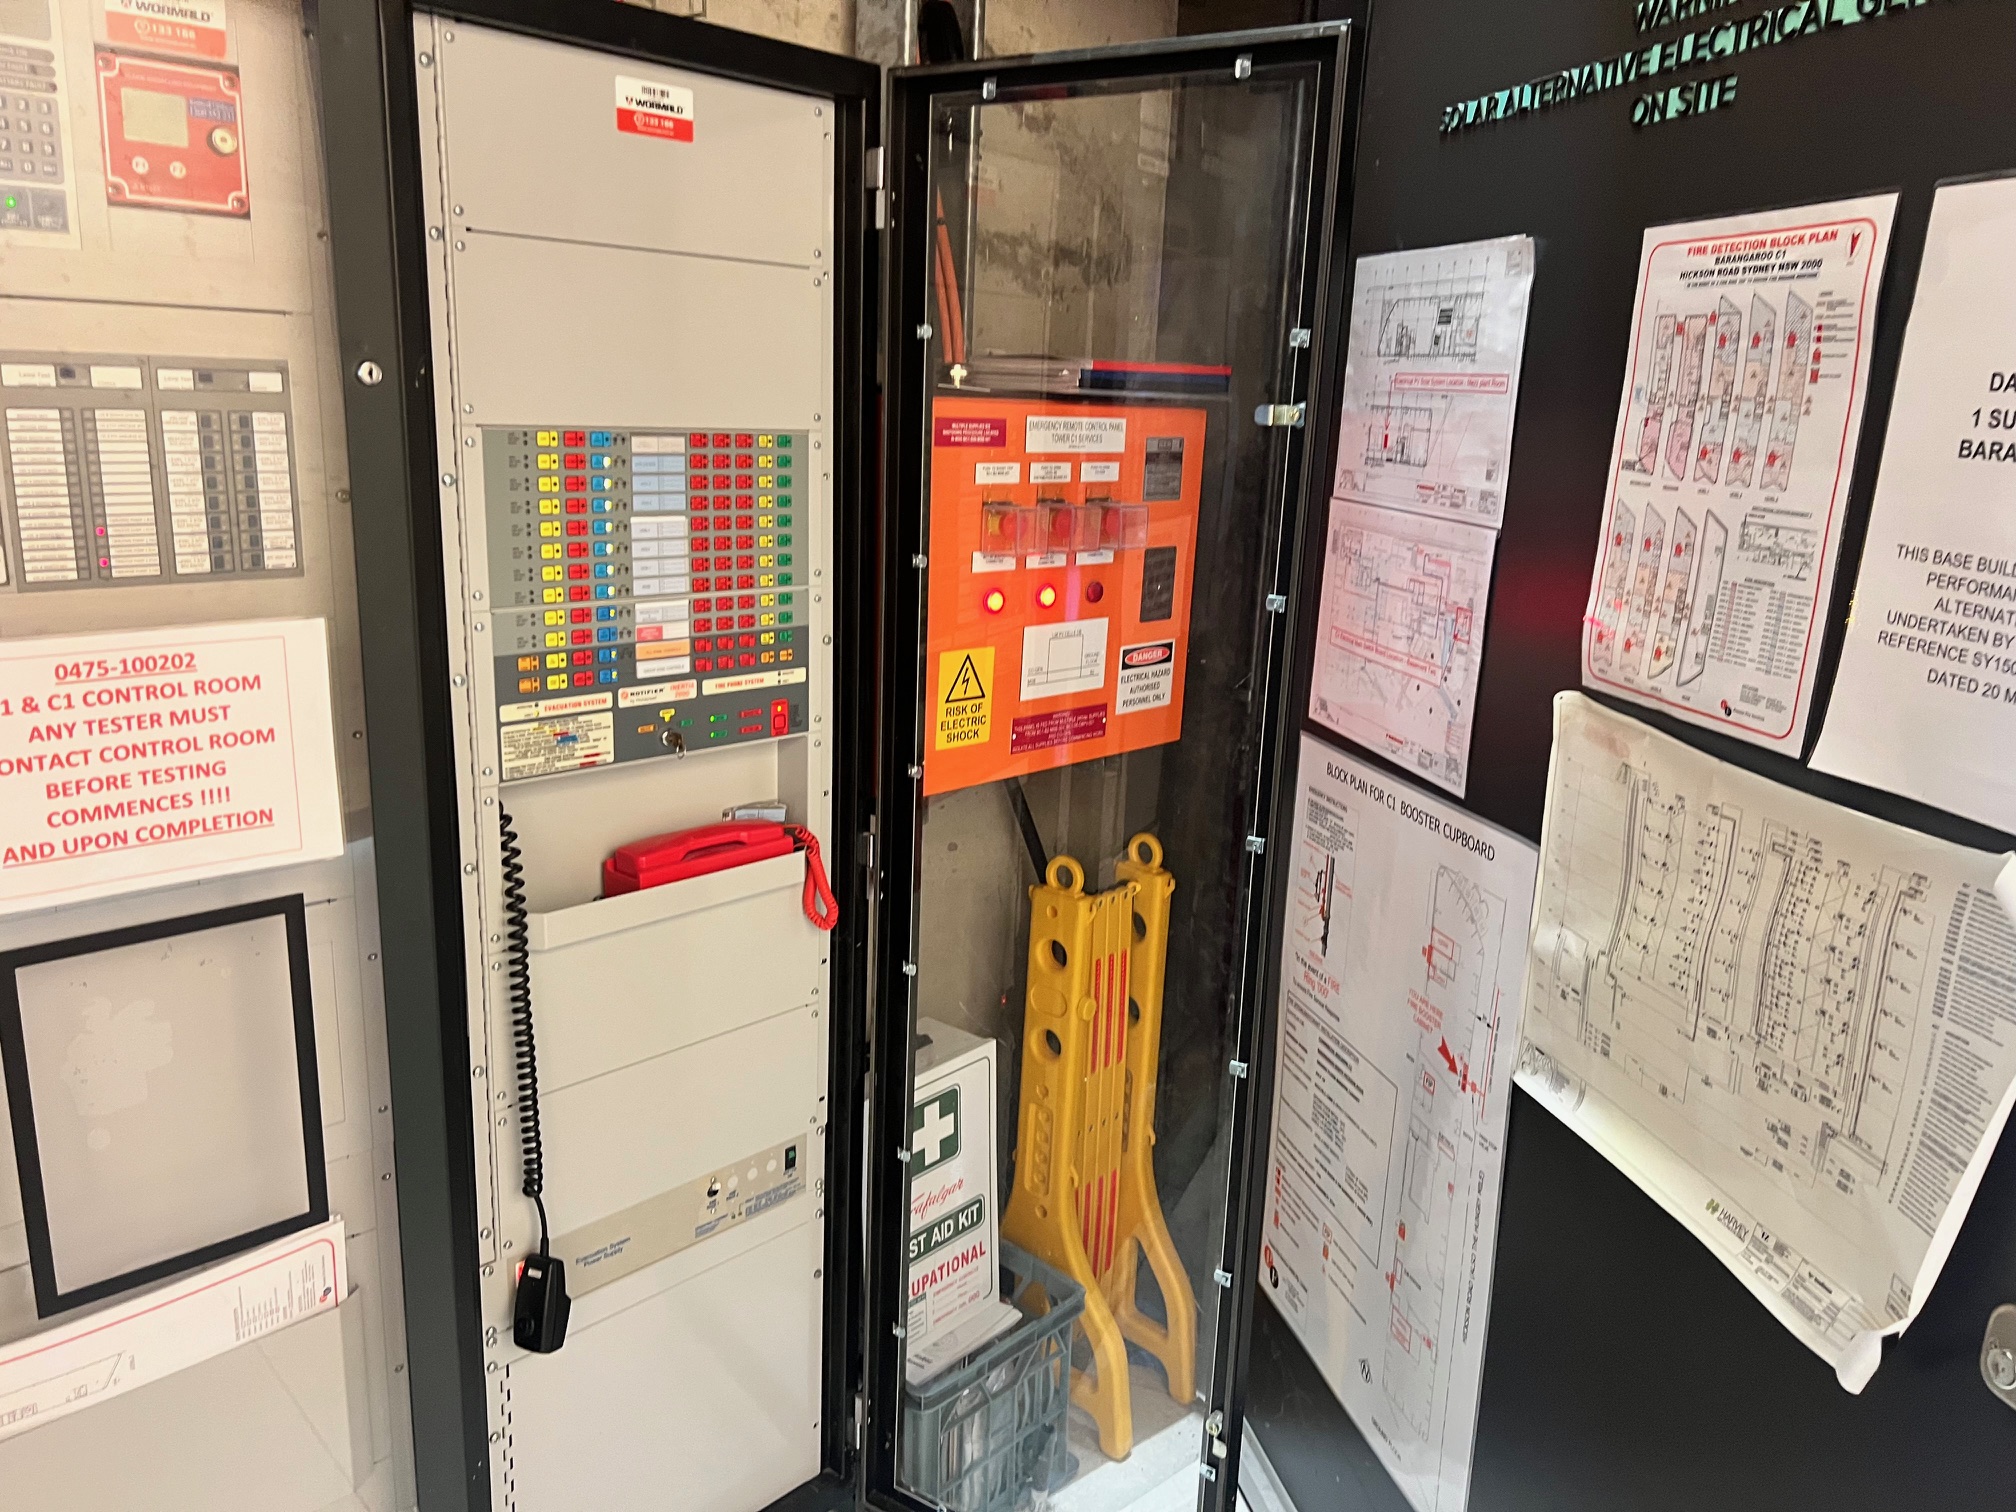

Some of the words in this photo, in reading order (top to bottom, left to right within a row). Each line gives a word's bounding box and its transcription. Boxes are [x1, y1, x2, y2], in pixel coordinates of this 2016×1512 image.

[1499, 50, 1654, 120] ALTERNATIVE
[1657, 0, 1846, 74] ELECTRICAL
[635, 98, 684, 115] WORMALD
[1629, 90, 1671, 127] ON
[1675, 73, 1740, 120] SITE
[1687, 244, 1708, 257] FIRE
[1710, 238, 1768, 255] DETECTION
[1770, 234, 1807, 249] BLOCK
[1808, 229, 1839, 244] PLAN
[1679, 268, 1715, 281] HICKSON
[1716, 265, 1740, 278] ROAD
[1741, 261, 1777, 275] SYDNEY
[1778, 260, 1800, 272] NSW
[1801, 258, 1824, 270] 2000
[1714, 251, 1774, 265] BARANGAROO
[1028, 420, 1062, 432] EMERGENCY
[1062, 421, 1084, 432] REMOTE
[1084, 421, 1108, 432] CONTROL
[1108, 422, 1124, 432] PANEL
[1972, 407, 1982, 428] 1
[1988, 408, 2016, 430] SU
[1051, 433, 1071, 443] TOWER
[1078, 433, 1103, 444] SERVICES
[1958, 438, 2016, 463] BARA
[1897, 543, 1929, 563] THIS
[1932, 549, 1974, 571] BASE
[1926, 571, 2016, 602] PERFORMA
[1933, 596, 2016, 628] ALTERNAT
[1887, 608, 1990, 645] UNDERTAKEN
[1992, 631, 2015, 650] BY
[1132, 649, 1163, 664] DANGER
[1877, 630, 1970, 664] REFERENCE
[54, 652, 197, 682] 0475-100202
[1120, 671, 1150, 684] ELECTRICAL
[1150, 668, 1171, 679] HAZARD
[21, 696, 41, 714] &
[47, 693, 75, 712] C1
[82, 682, 188, 708] CONTROL
[194, 675, 262, 697] ROOM
[744, 678, 765, 686] SYSTEM
[1130, 681, 1161, 694] AUTHORISED
[1926, 667, 1979, 694] DATED
[1981, 682, 2001, 700] 20
[544, 701, 582, 713] EVACUATION
[583, 698, 607, 706] SYSTEM
[945, 704, 968, 718] RISK
[970, 702, 983, 714] OF
[1122, 695, 1151, 708] PERSONNEL
[1152, 692, 1166, 703] ONLY
[28, 721, 77, 743] ANY
[83, 713, 164, 737] TESTER
[169, 704, 231, 727] MUST
[940, 714, 987, 731] ELECTRIC
[946, 728, 979, 743] SHOCK
[99, 737, 204, 764] CONTROL
[209, 727, 276, 750] ROOM
[46, 773, 132, 800] BEFORE
[138, 760, 227, 787] TESTING
[46, 791, 194, 829] COMMENCES
[201, 786, 231, 806] !!!!
[1326, 761, 1348, 784] BLOCK
[1349, 773, 1368, 796] PLAN
[1369, 785, 1385, 806] FOR
[1386, 794, 1396, 811] C1
[1400, 800, 1440, 834] BOOSTER
[1443, 822, 1495, 861] CUPBOARD
[3, 842, 55, 865] AND
[62, 829, 128, 856] UPON
[135, 808, 274, 842] COMPLETION
[930, 1219, 954, 1248] AID
[958, 1203, 980, 1230] KIT
[1717, 1207, 1750, 1240] HARVEY
